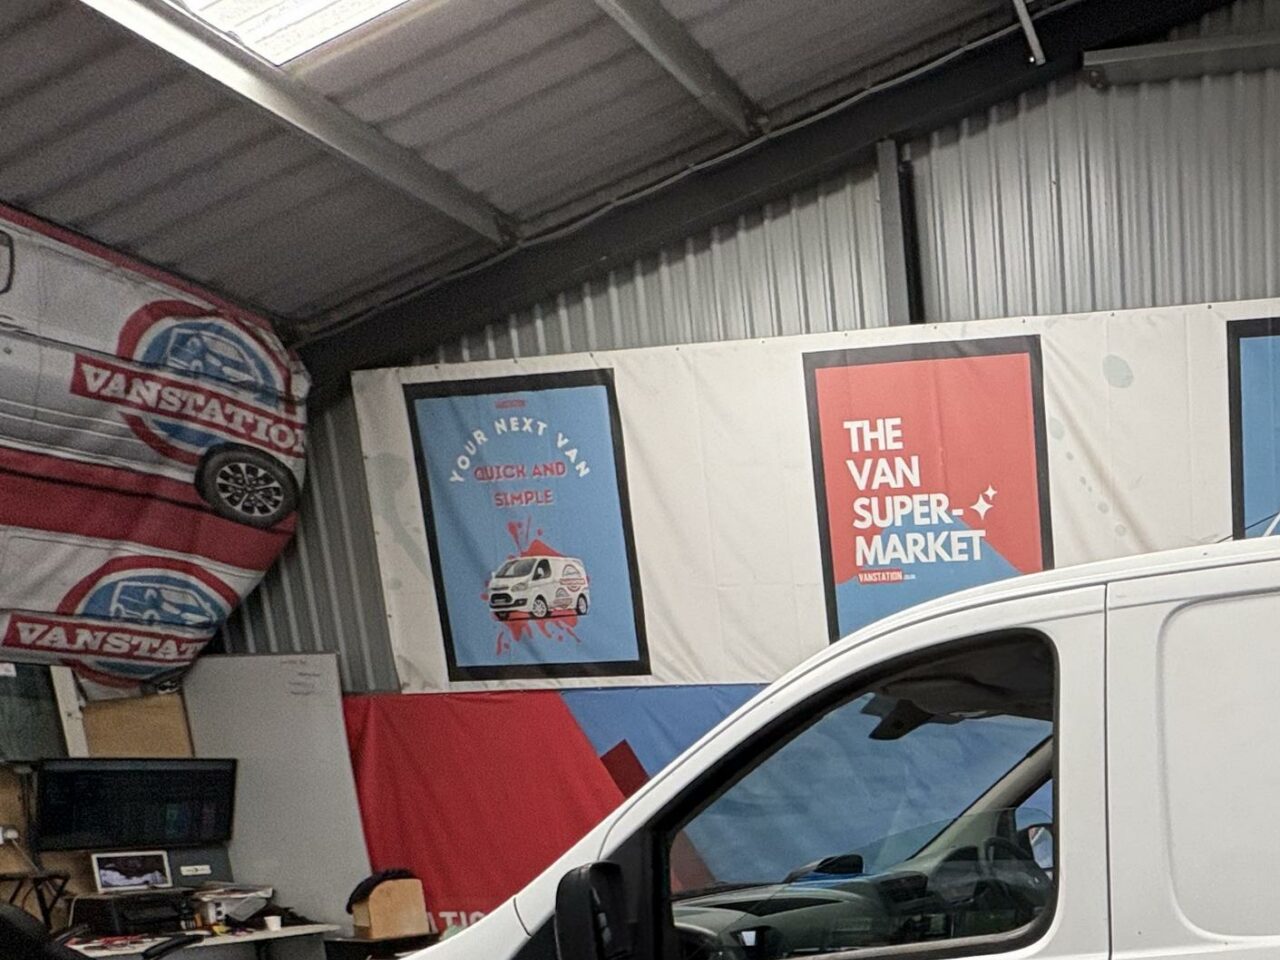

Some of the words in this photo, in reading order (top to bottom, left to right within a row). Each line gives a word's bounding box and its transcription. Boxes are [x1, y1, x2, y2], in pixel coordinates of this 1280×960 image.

[450, 428, 489, 484] YOUR
[494, 416, 548, 436] NEXT
[555, 432, 591, 478] VAN
[843, 417, 904, 453] THE
[473, 464, 526, 482] QUICK
[532, 461, 567, 479] AND
[846, 455, 921, 491] VAN
[493, 489, 554, 507] SIMPLE
[853, 492, 964, 529] SUPER-
[855, 529, 987, 567] MARKET
